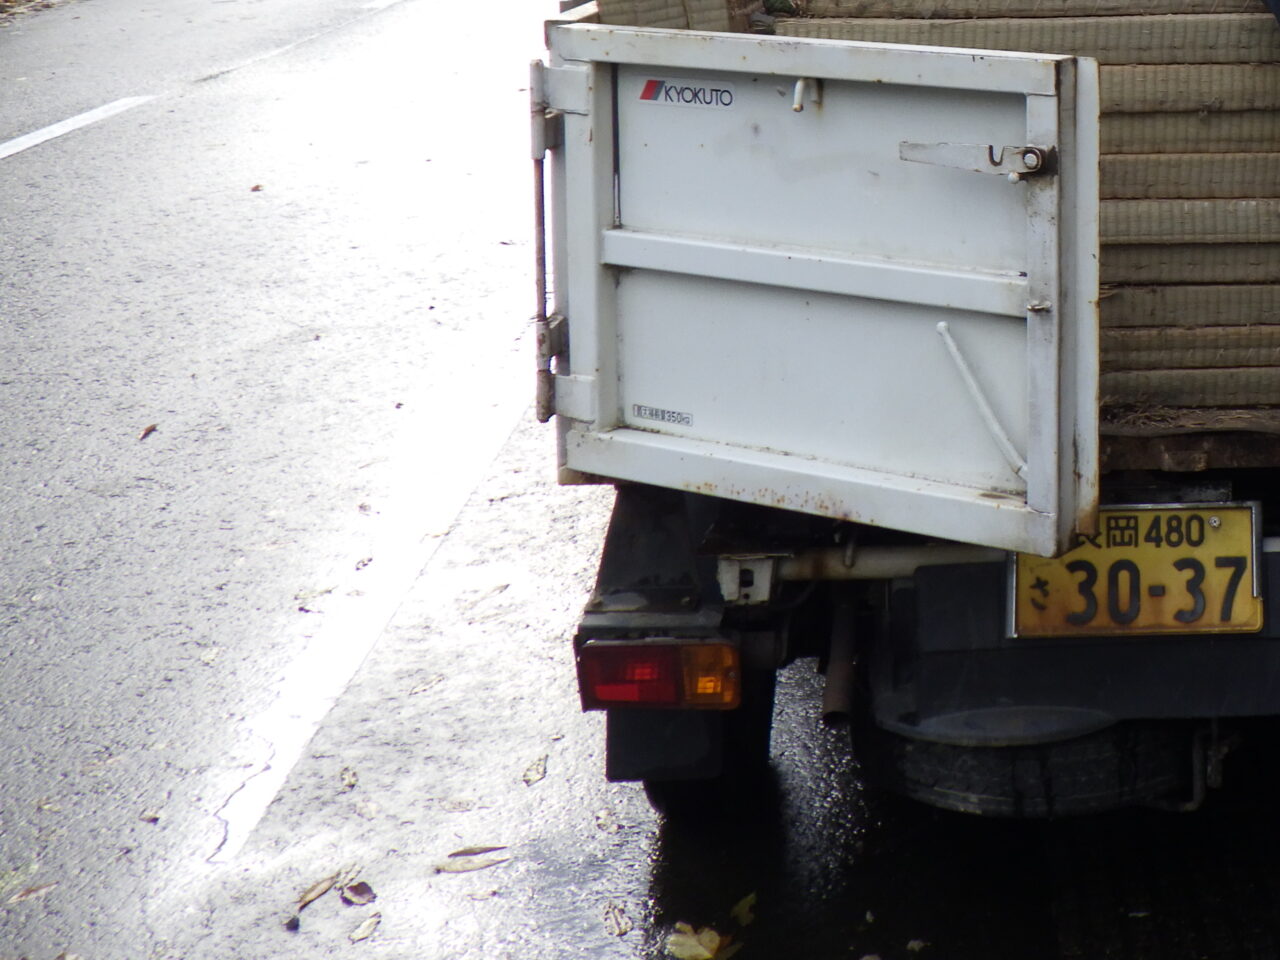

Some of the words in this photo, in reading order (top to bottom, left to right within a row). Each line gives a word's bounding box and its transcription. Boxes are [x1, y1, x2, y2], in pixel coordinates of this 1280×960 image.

[664, 85, 733, 107] KYOKUTO
[1144, 514, 1205, 548] 480
[1030, 576, 1050, 611] さ
[1065, 556, 1248, 626] 30-37
